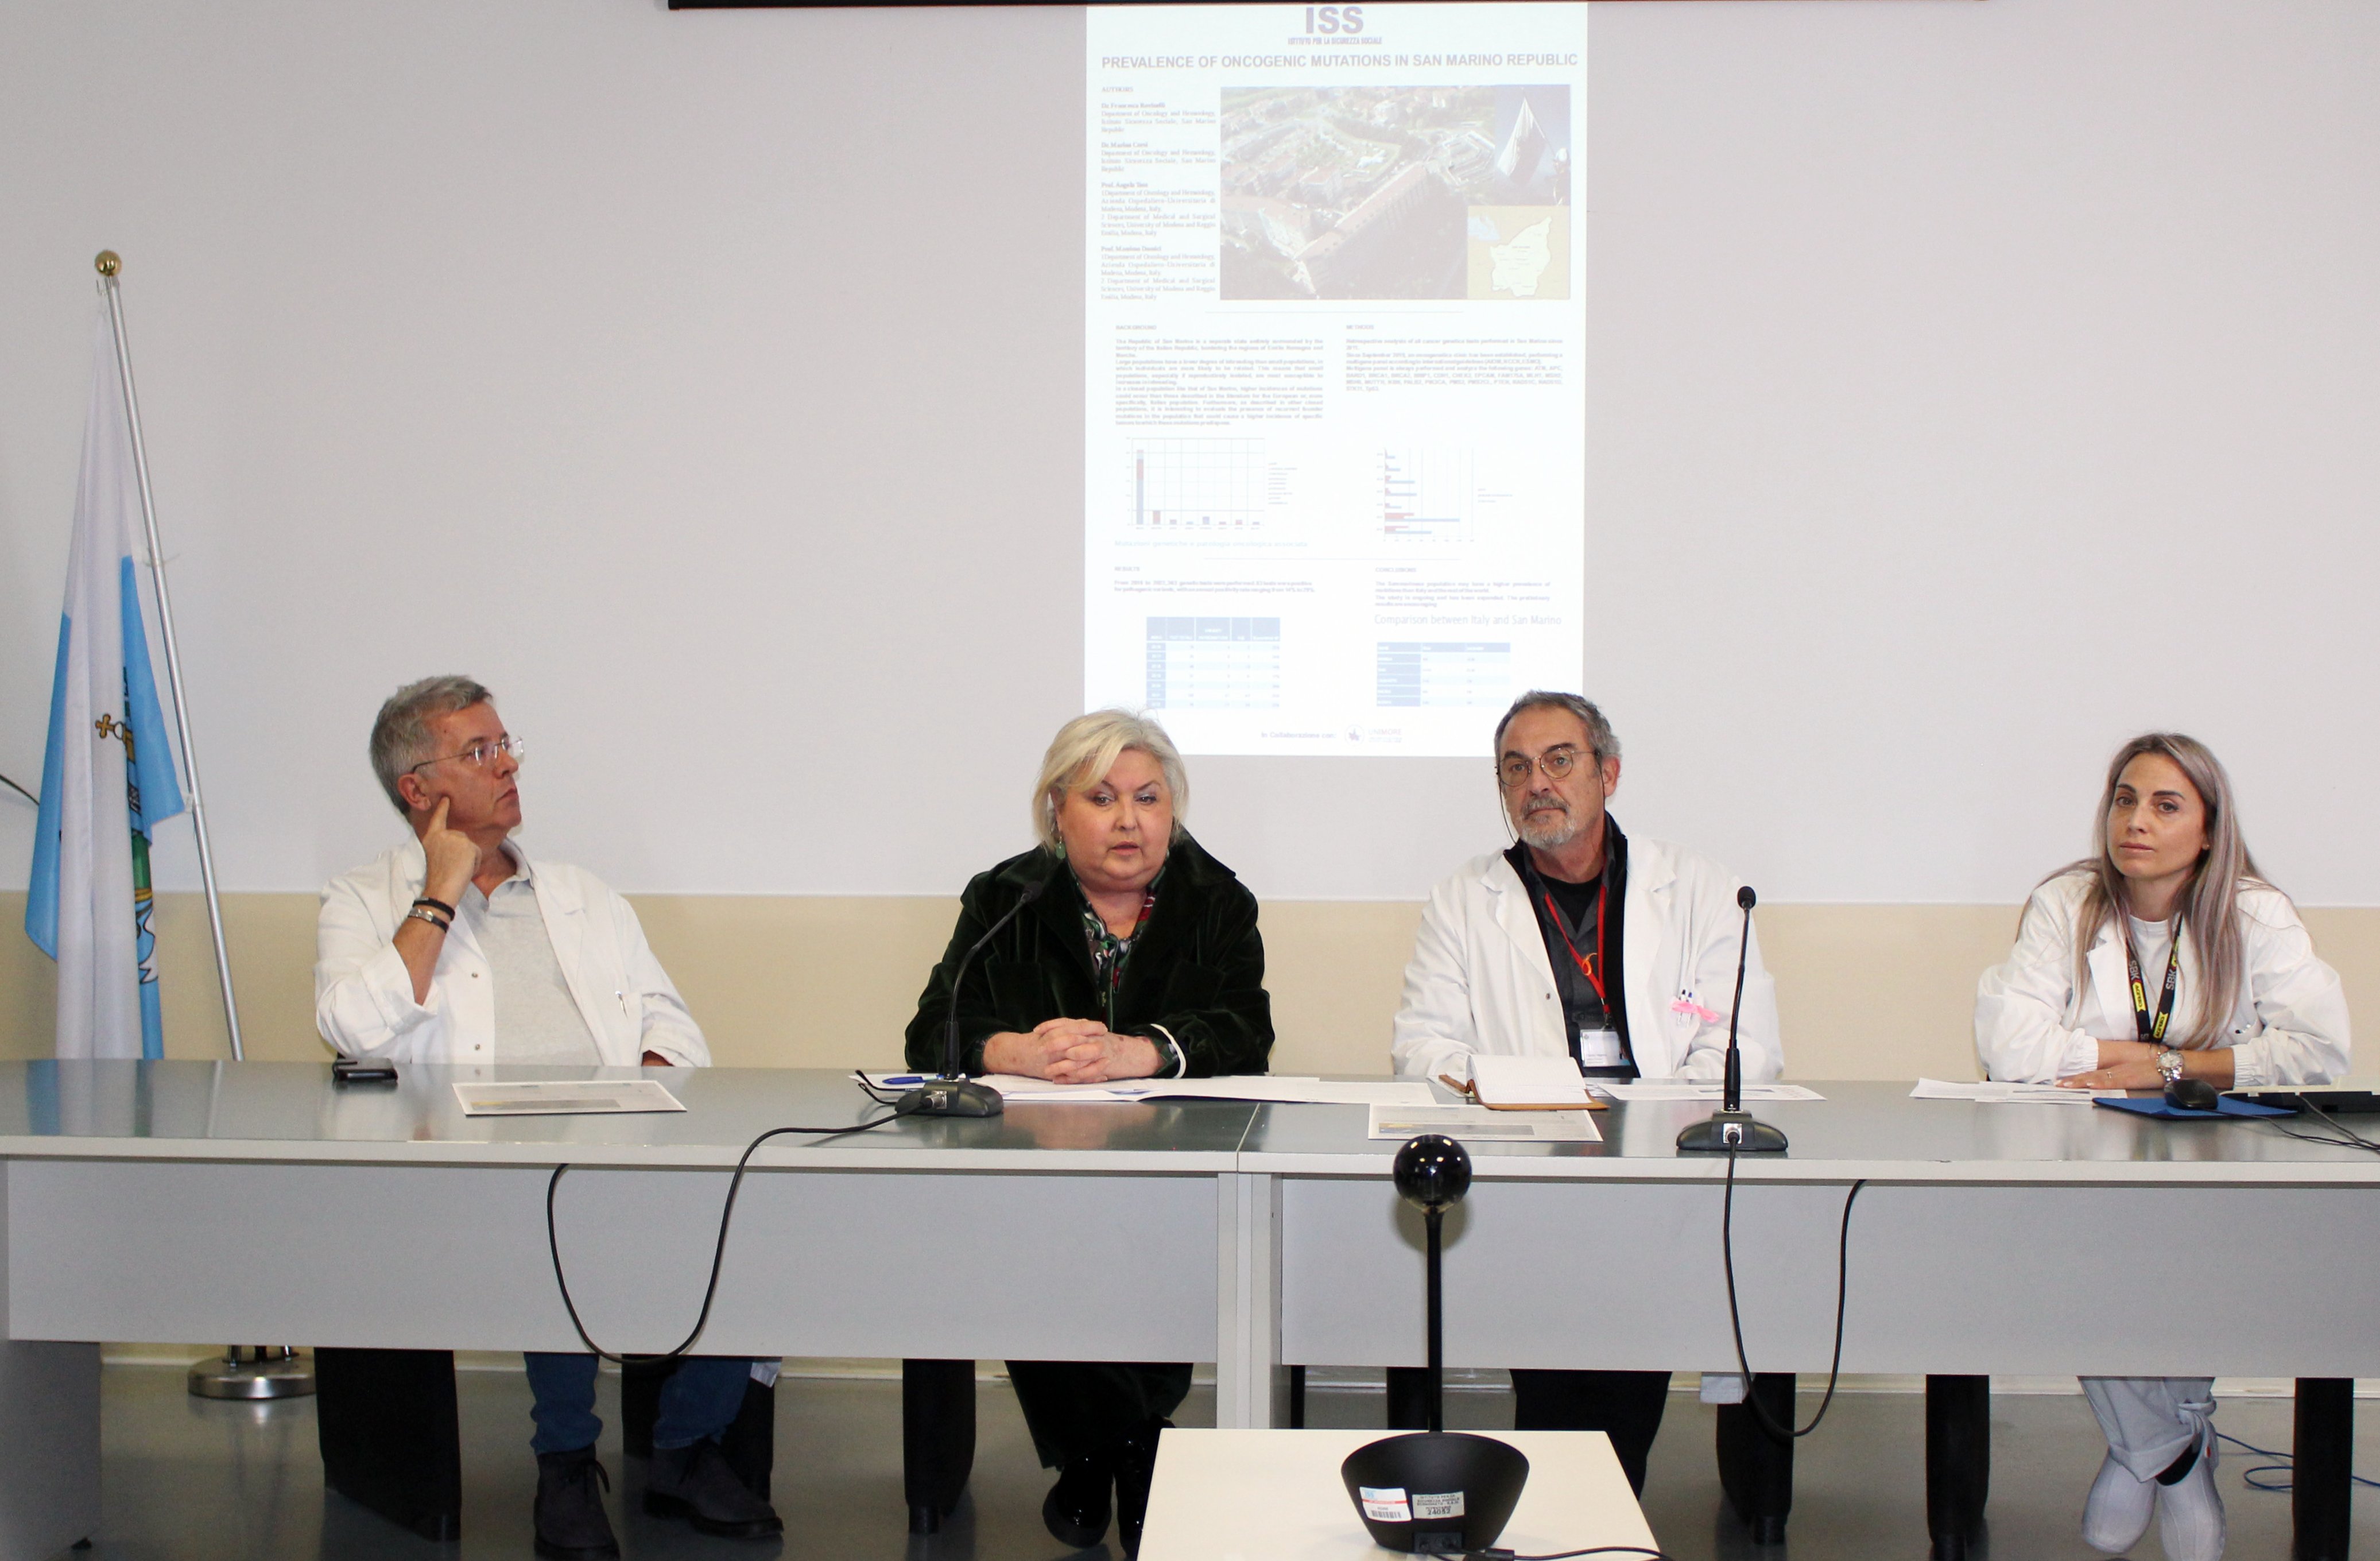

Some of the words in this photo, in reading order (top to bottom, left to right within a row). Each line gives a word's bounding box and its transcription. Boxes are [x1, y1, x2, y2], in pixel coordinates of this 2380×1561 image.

[1306, 6, 1363, 34] ISS
[1102, 56, 1194, 69] PREVALENCE
[1199, 56, 1217, 68] OF
[1222, 55, 1307, 68] ONCOGENIC
[1311, 55, 1391, 67] MUTATIONS
[1395, 55, 1409, 67] IN
[1413, 55, 1441, 67] SAN
[1447, 54, 1502, 66] MARINO
[1507, 53, 1578, 66] REPUBLIC
[1374, 614, 1428, 626] Comparison
[1431, 614, 1468, 626] between
[1471, 614, 1490, 626] Italy
[1493, 614, 1509, 626] and
[1512, 614, 1528, 626] San
[1531, 614, 1562, 626] Marino
[2129, 960, 2140, 981] SBK
[2165, 969, 2177, 990] SBK
